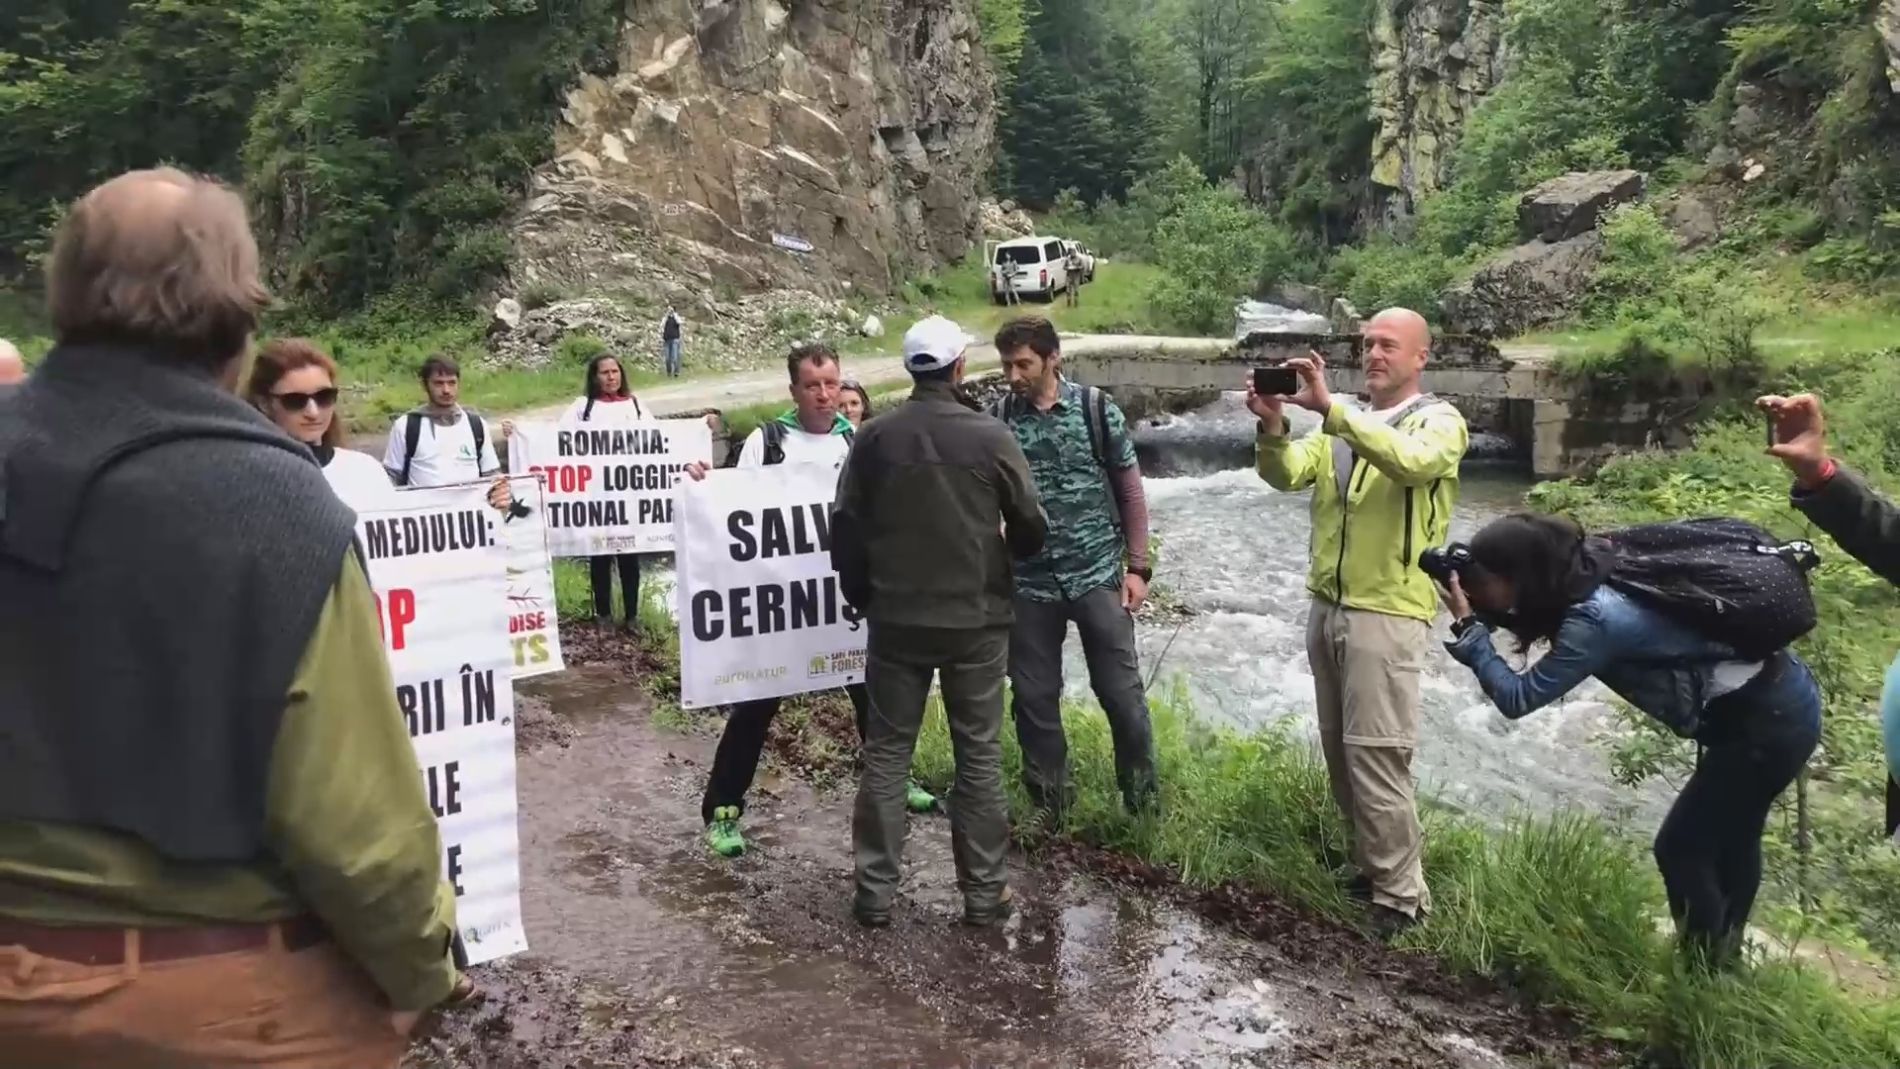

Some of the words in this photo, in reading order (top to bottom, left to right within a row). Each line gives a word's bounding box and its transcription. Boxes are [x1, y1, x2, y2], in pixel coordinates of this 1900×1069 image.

[557, 429, 669, 457] ROMANIA:
[603, 463, 688, 492] LOGGI
[548, 498, 630, 528] TIONAL
[365, 509, 495, 560] MEDIULUI:
[726, 501, 836, 562] SALV
[509, 611, 546, 634] DISE
[511, 634, 550, 667] TS
[831, 656, 865, 673] FORES
[396, 678, 446, 738] RII
[459, 663, 496, 727] ÎN
[427, 760, 462, 818] LE
